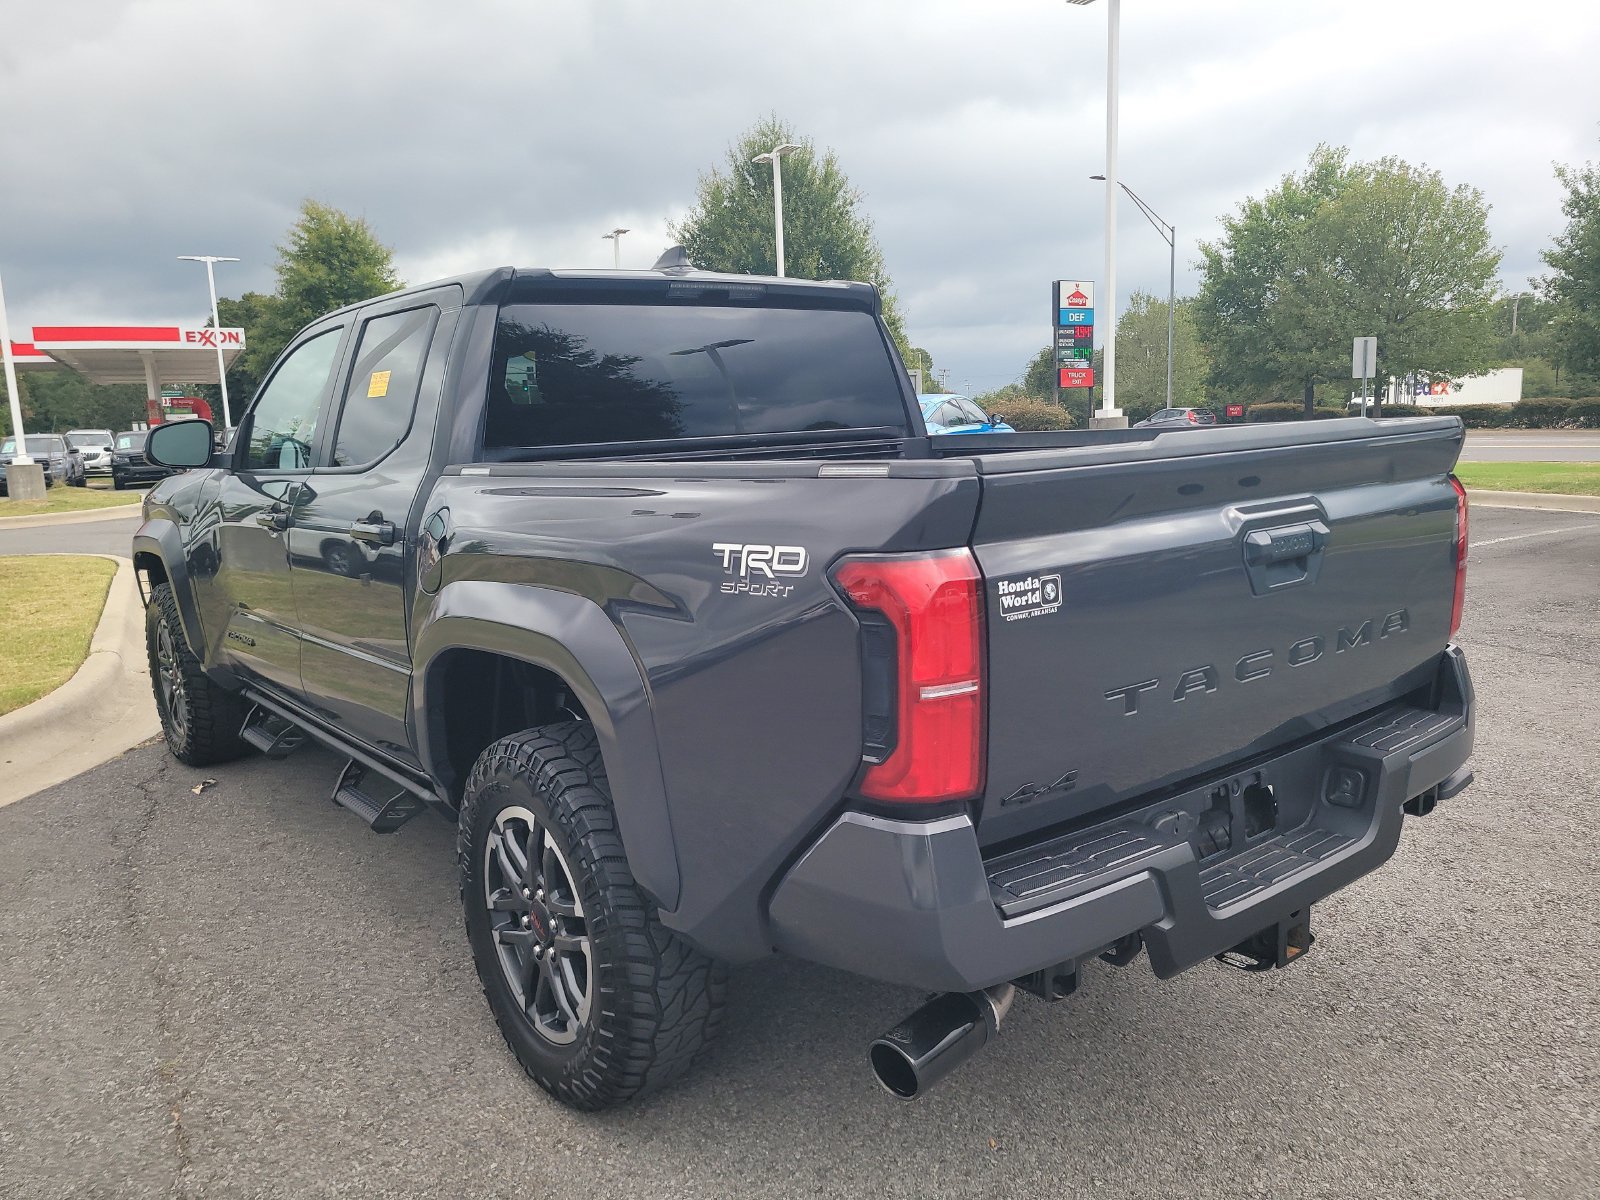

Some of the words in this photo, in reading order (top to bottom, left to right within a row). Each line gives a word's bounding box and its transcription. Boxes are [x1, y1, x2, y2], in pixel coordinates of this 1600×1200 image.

[1069, 313, 1085, 322] DEF
[185, 329, 240, 348] EXXON
[712, 543, 806, 578] TRD
[720, 582, 794, 598] SPORT
[998, 577, 1040, 595] Honda
[1001, 590, 1041, 609] World
[1030, 606, 1058, 618] ARKANSAS
[1104, 608, 1409, 716] TACOMA
[1001, 769, 1078, 806] 4x4
